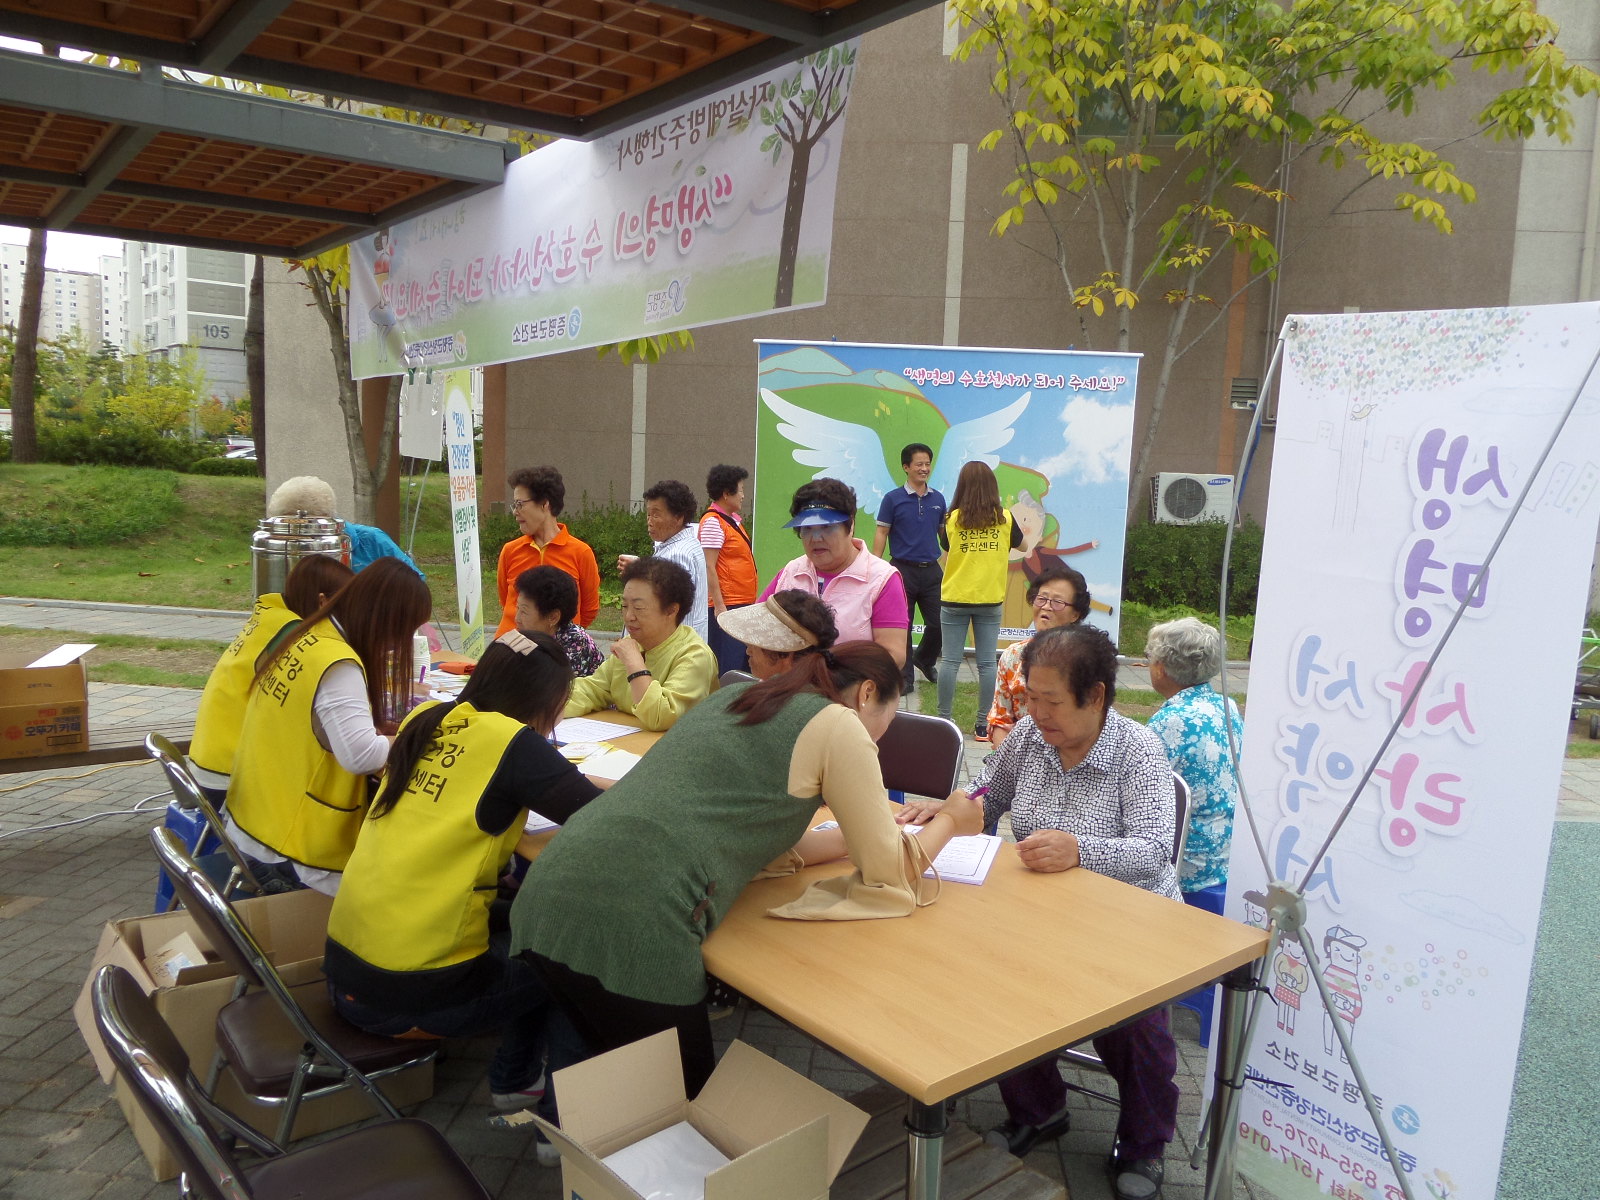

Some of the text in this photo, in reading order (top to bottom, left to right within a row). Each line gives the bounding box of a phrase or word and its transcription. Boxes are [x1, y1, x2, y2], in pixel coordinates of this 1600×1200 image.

[203, 325, 230, 339] 105
[904, 368, 1126, 391] “생명의 수호천사가 되어 주세요!”
[959, 529, 1000, 541] 정신건강
[960, 541, 999, 553] 증진센터
